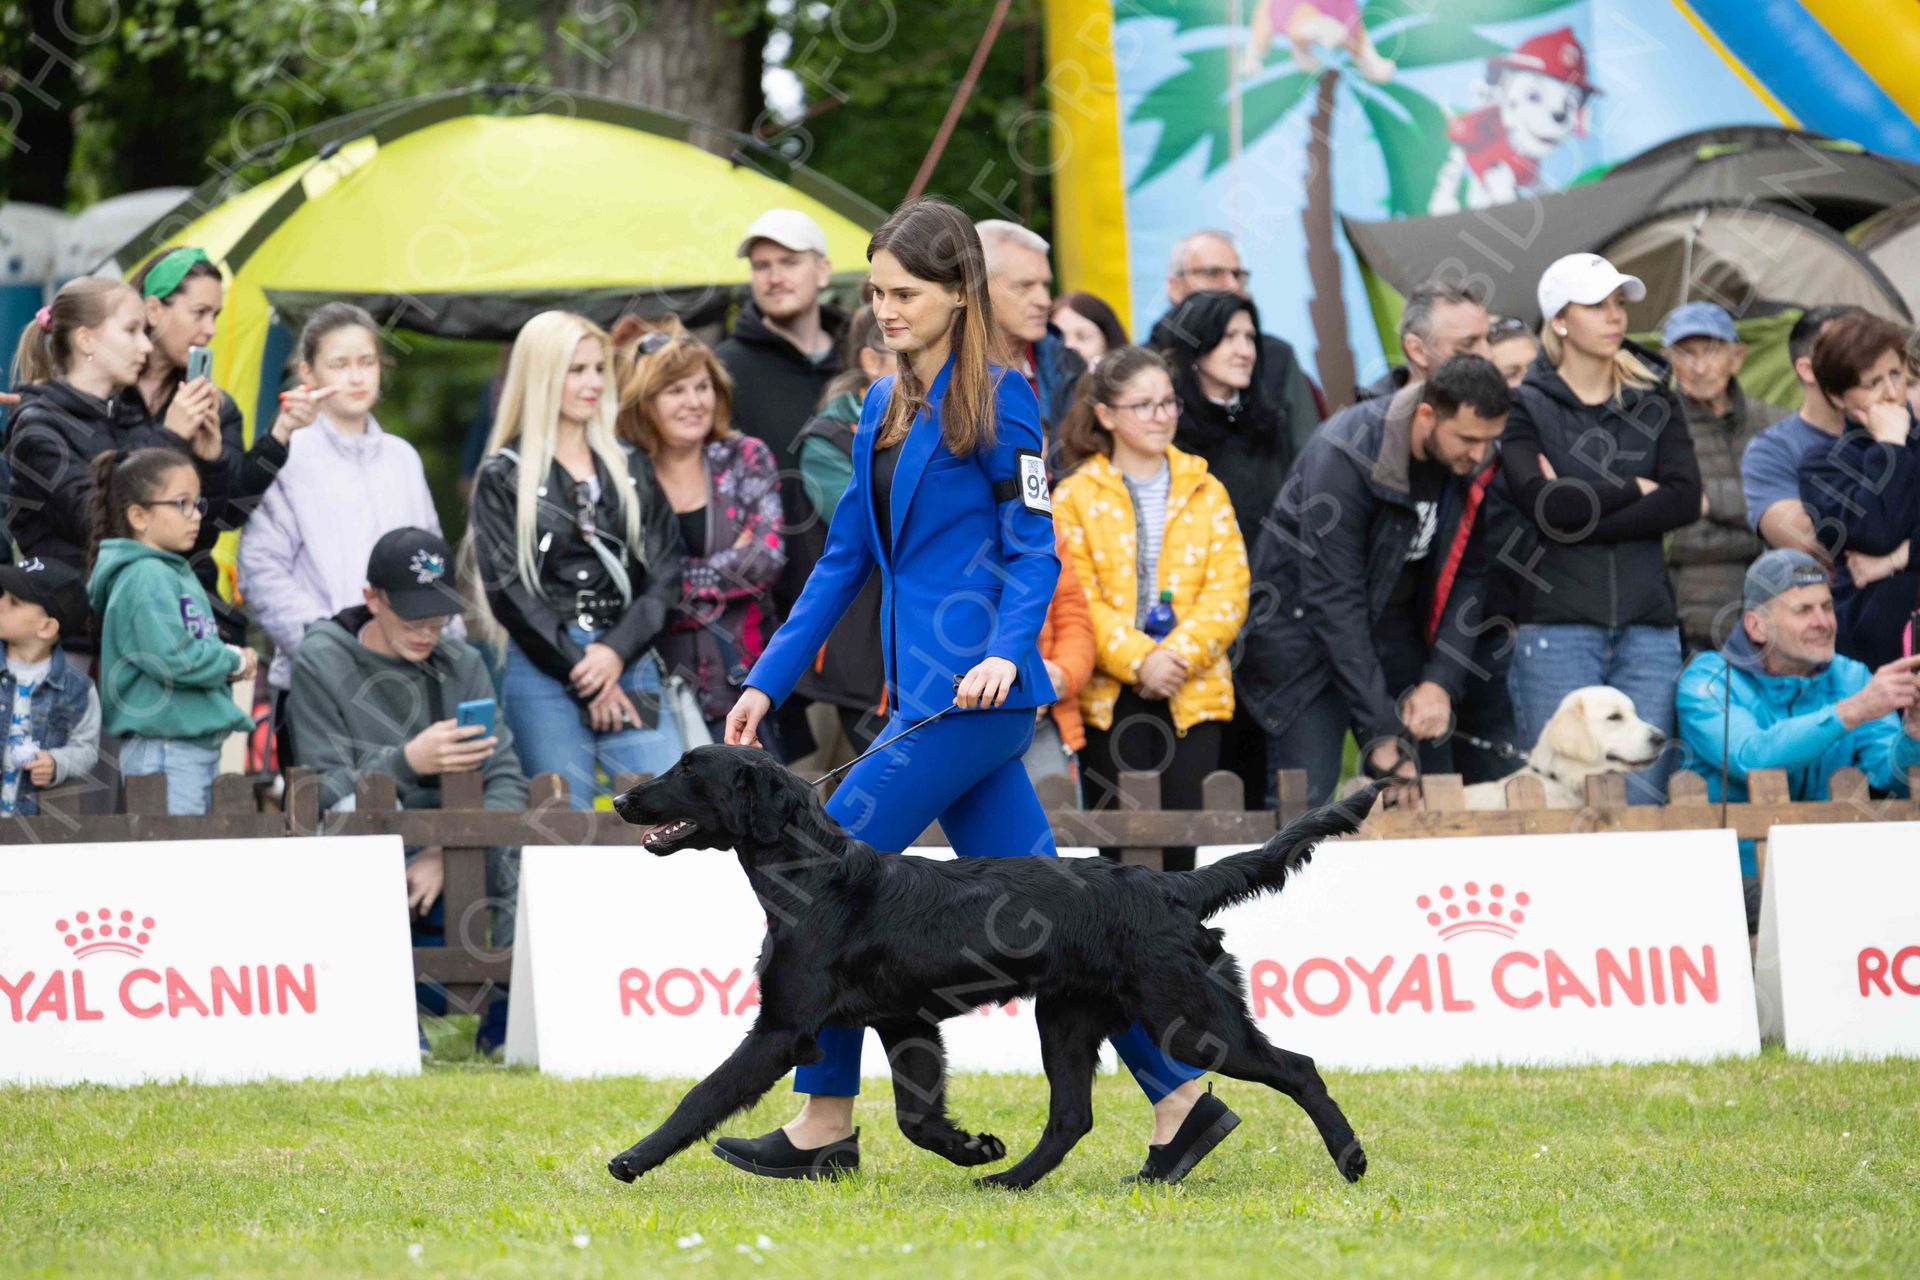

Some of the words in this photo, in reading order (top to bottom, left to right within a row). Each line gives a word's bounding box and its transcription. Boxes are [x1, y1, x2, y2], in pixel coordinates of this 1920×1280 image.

[1027, 474, 1049, 501] 92
[119, 963, 316, 1018] CANIN
[1251, 953, 1474, 1018] ROYAL
[1491, 945, 1719, 1010] CANIN
